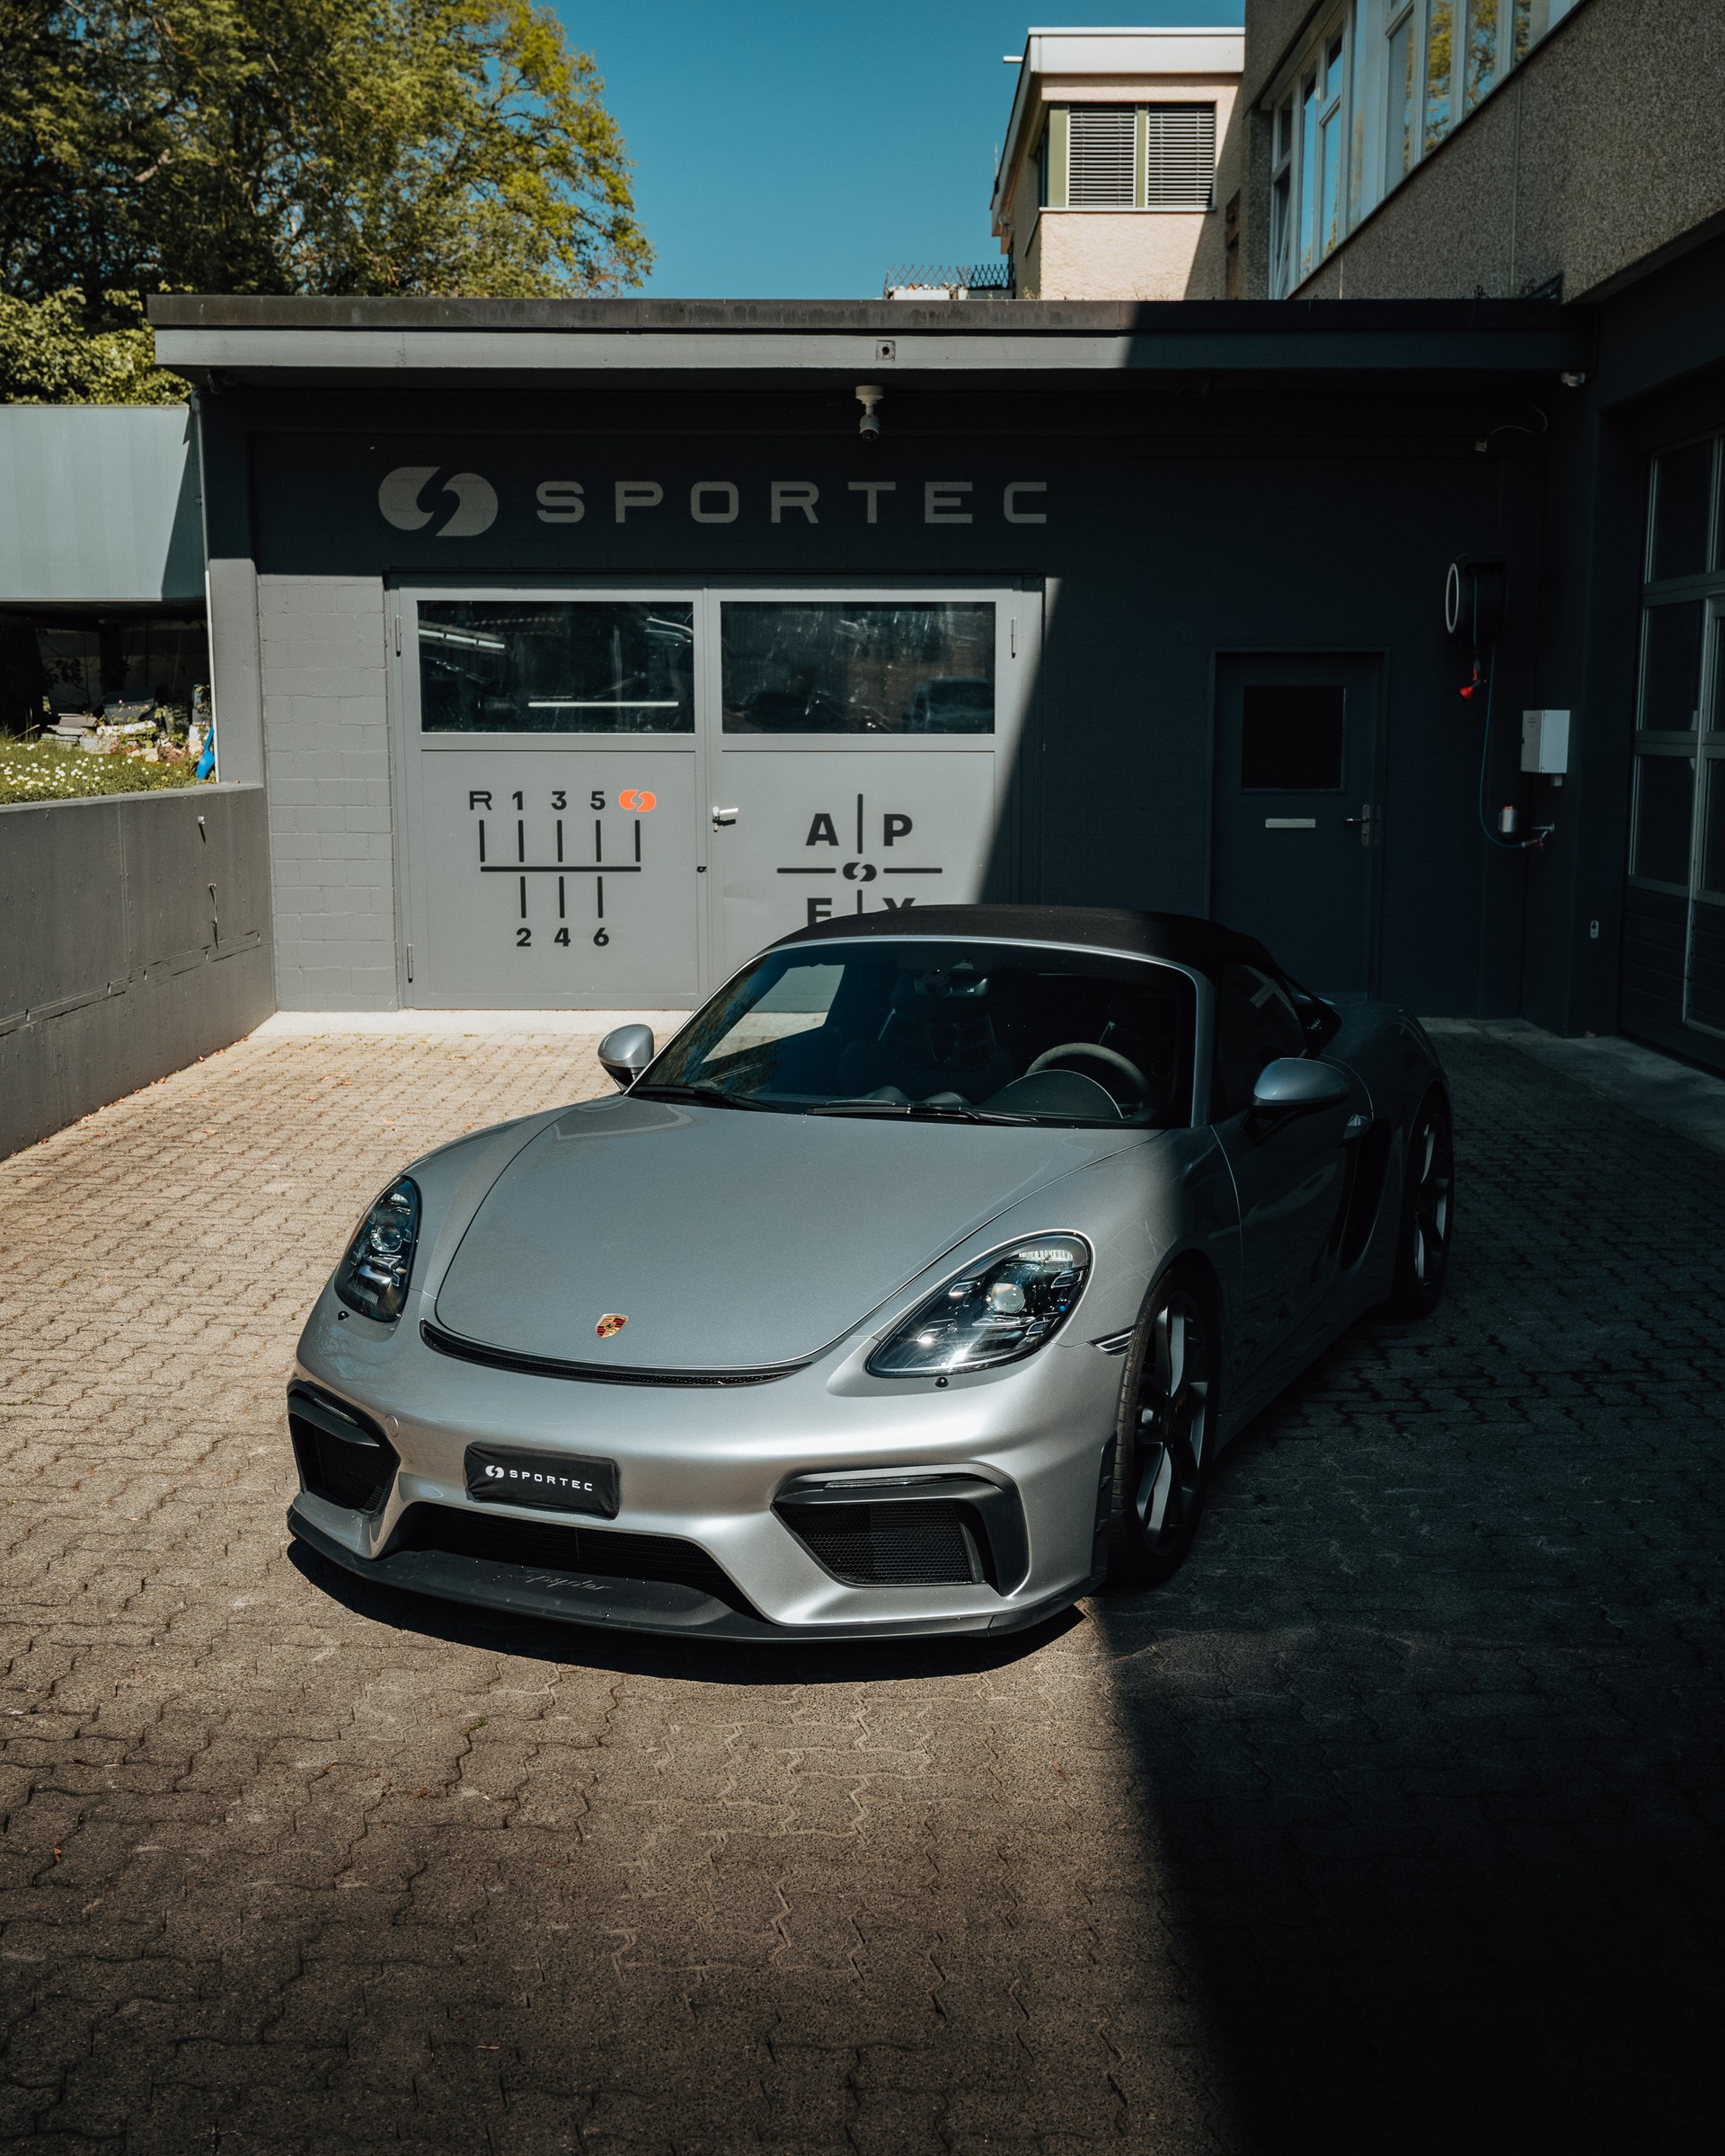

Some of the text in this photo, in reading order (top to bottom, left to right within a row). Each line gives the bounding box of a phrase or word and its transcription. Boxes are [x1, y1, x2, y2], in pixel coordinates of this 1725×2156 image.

[536, 482, 1048, 524] SPORTEC
[470, 791, 606, 810] R 1 3 5
[806, 814, 913, 846] A P
[516, 928, 609, 947] 2 4 6
[509, 1470, 593, 1491] SPORTEC
